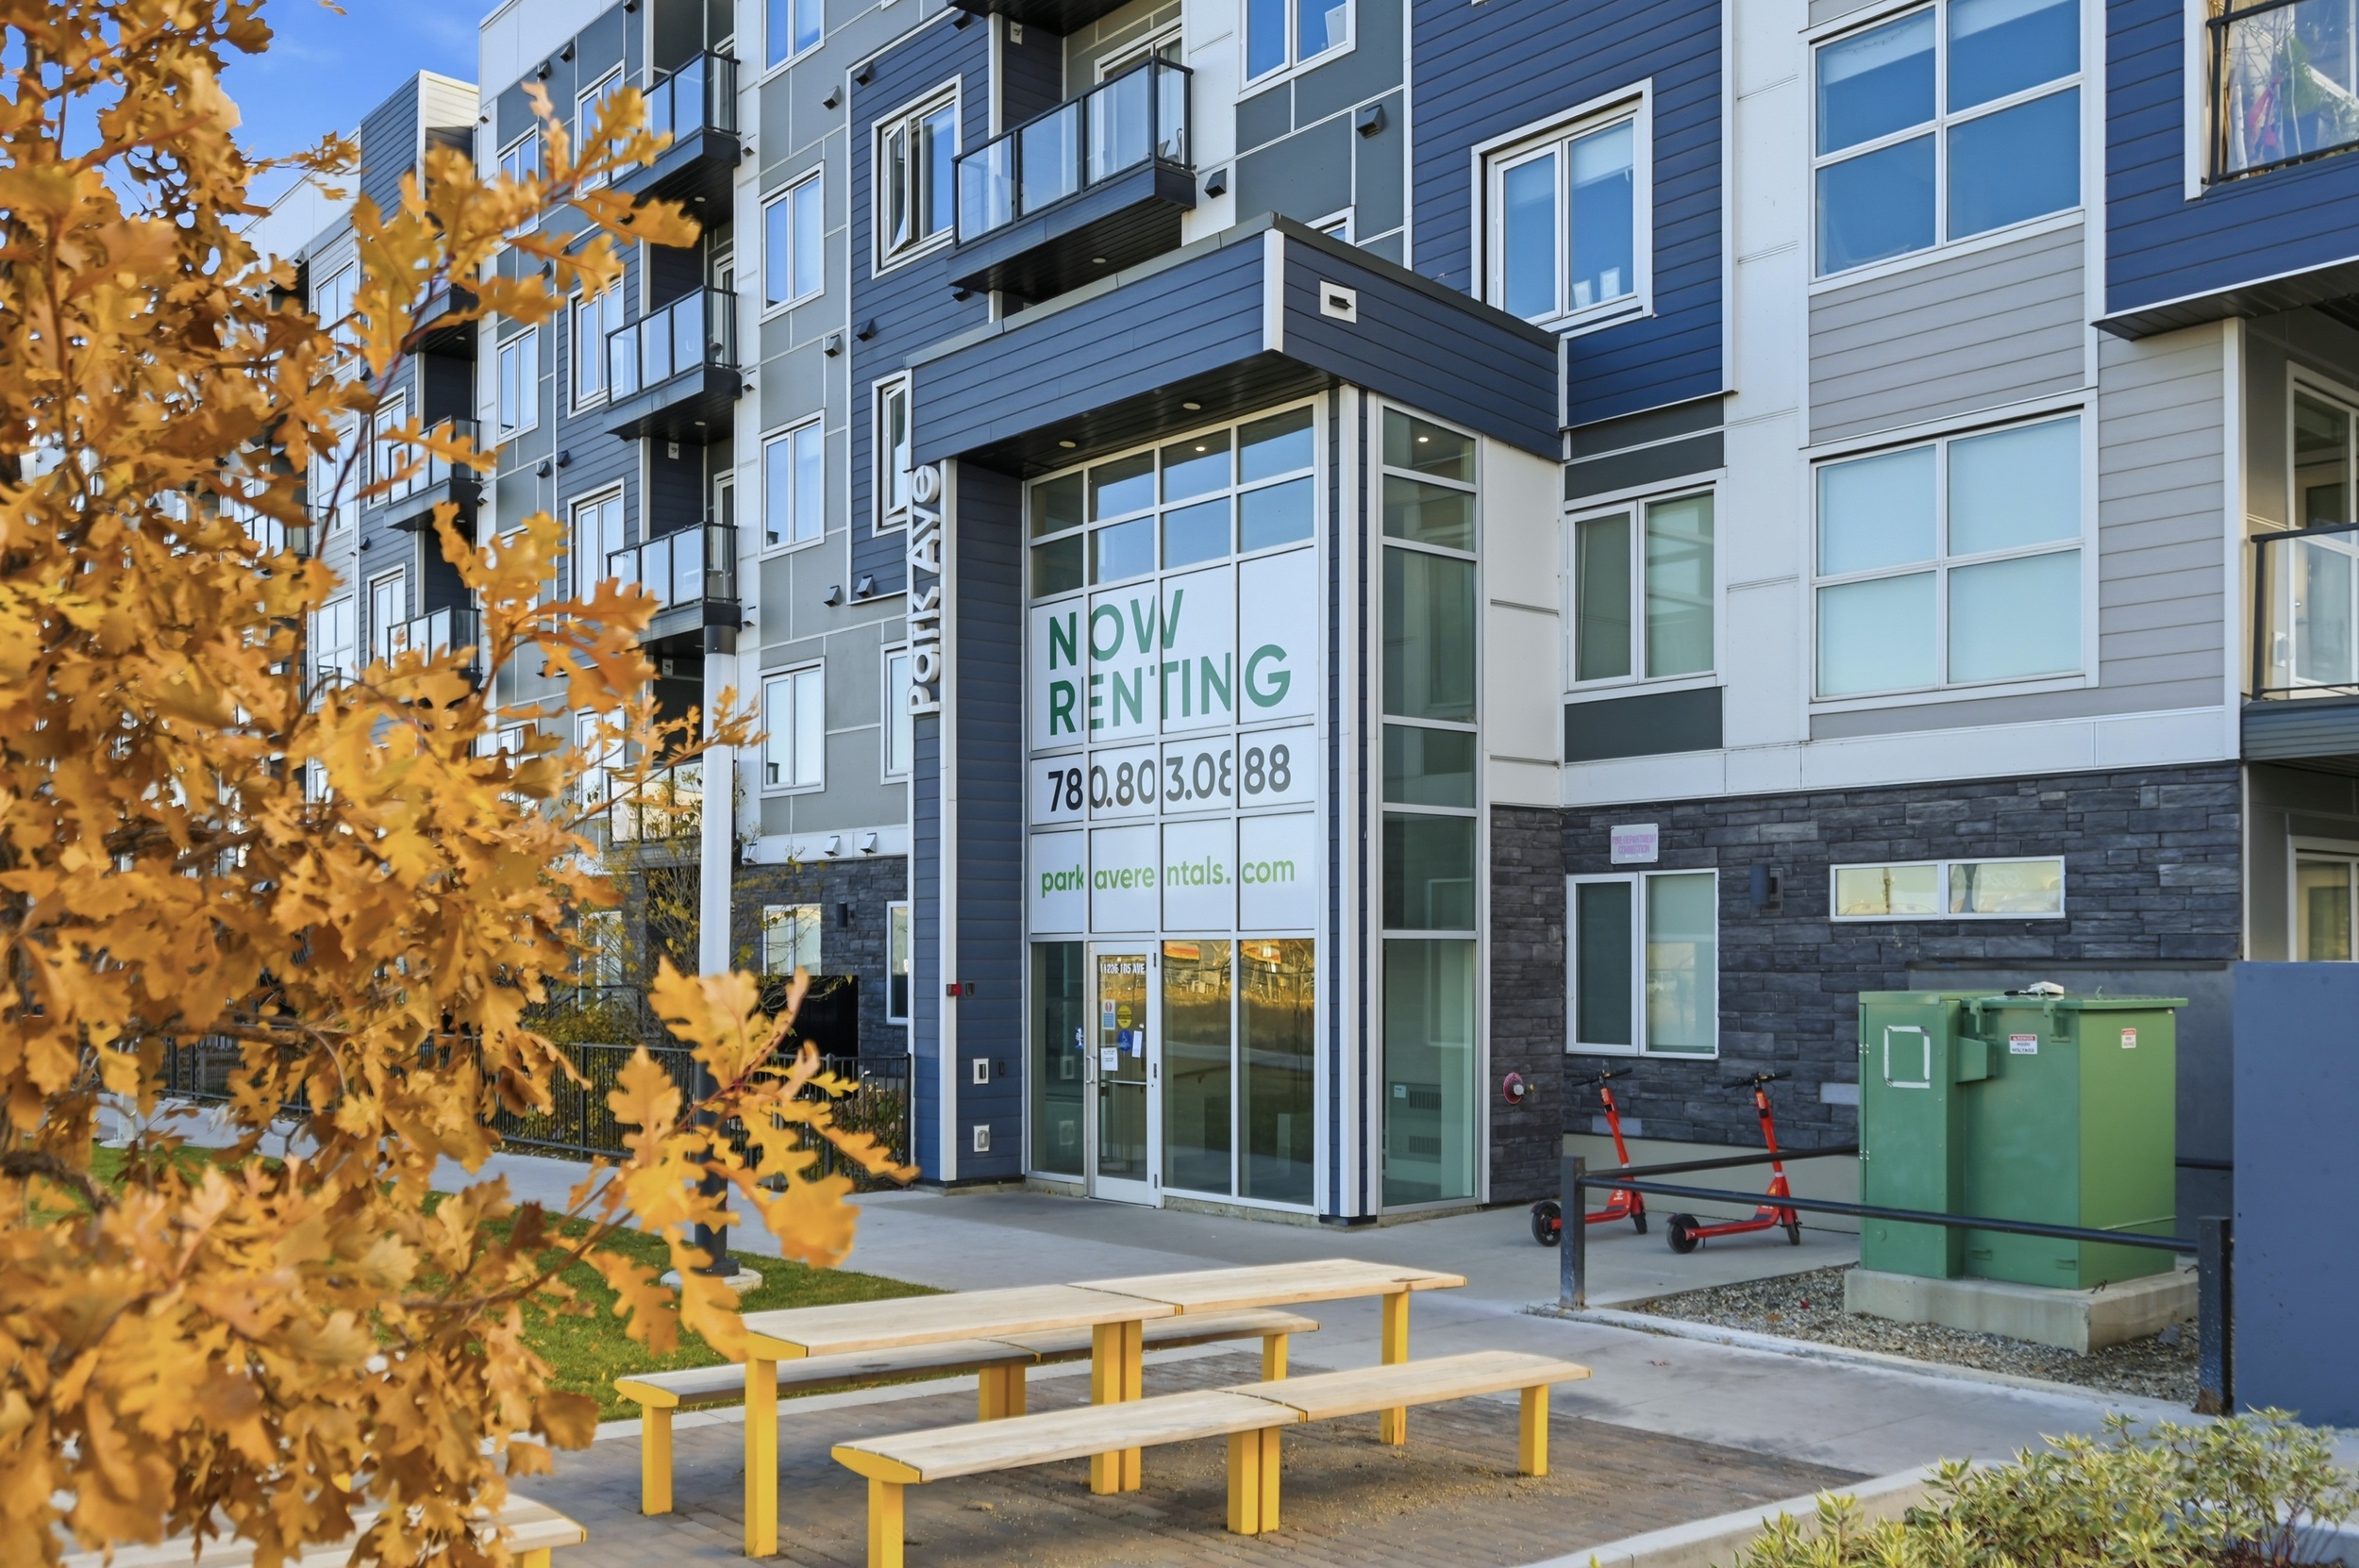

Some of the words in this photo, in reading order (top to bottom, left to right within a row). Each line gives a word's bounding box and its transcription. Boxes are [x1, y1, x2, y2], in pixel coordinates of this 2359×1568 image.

[906, 464, 941, 575] Ave
[906, 586, 941, 716] Park
[1049, 589, 1184, 670] NOW
[1049, 643, 1291, 736] RENTING
[1047, 743, 1291, 812] 780.803.0888
